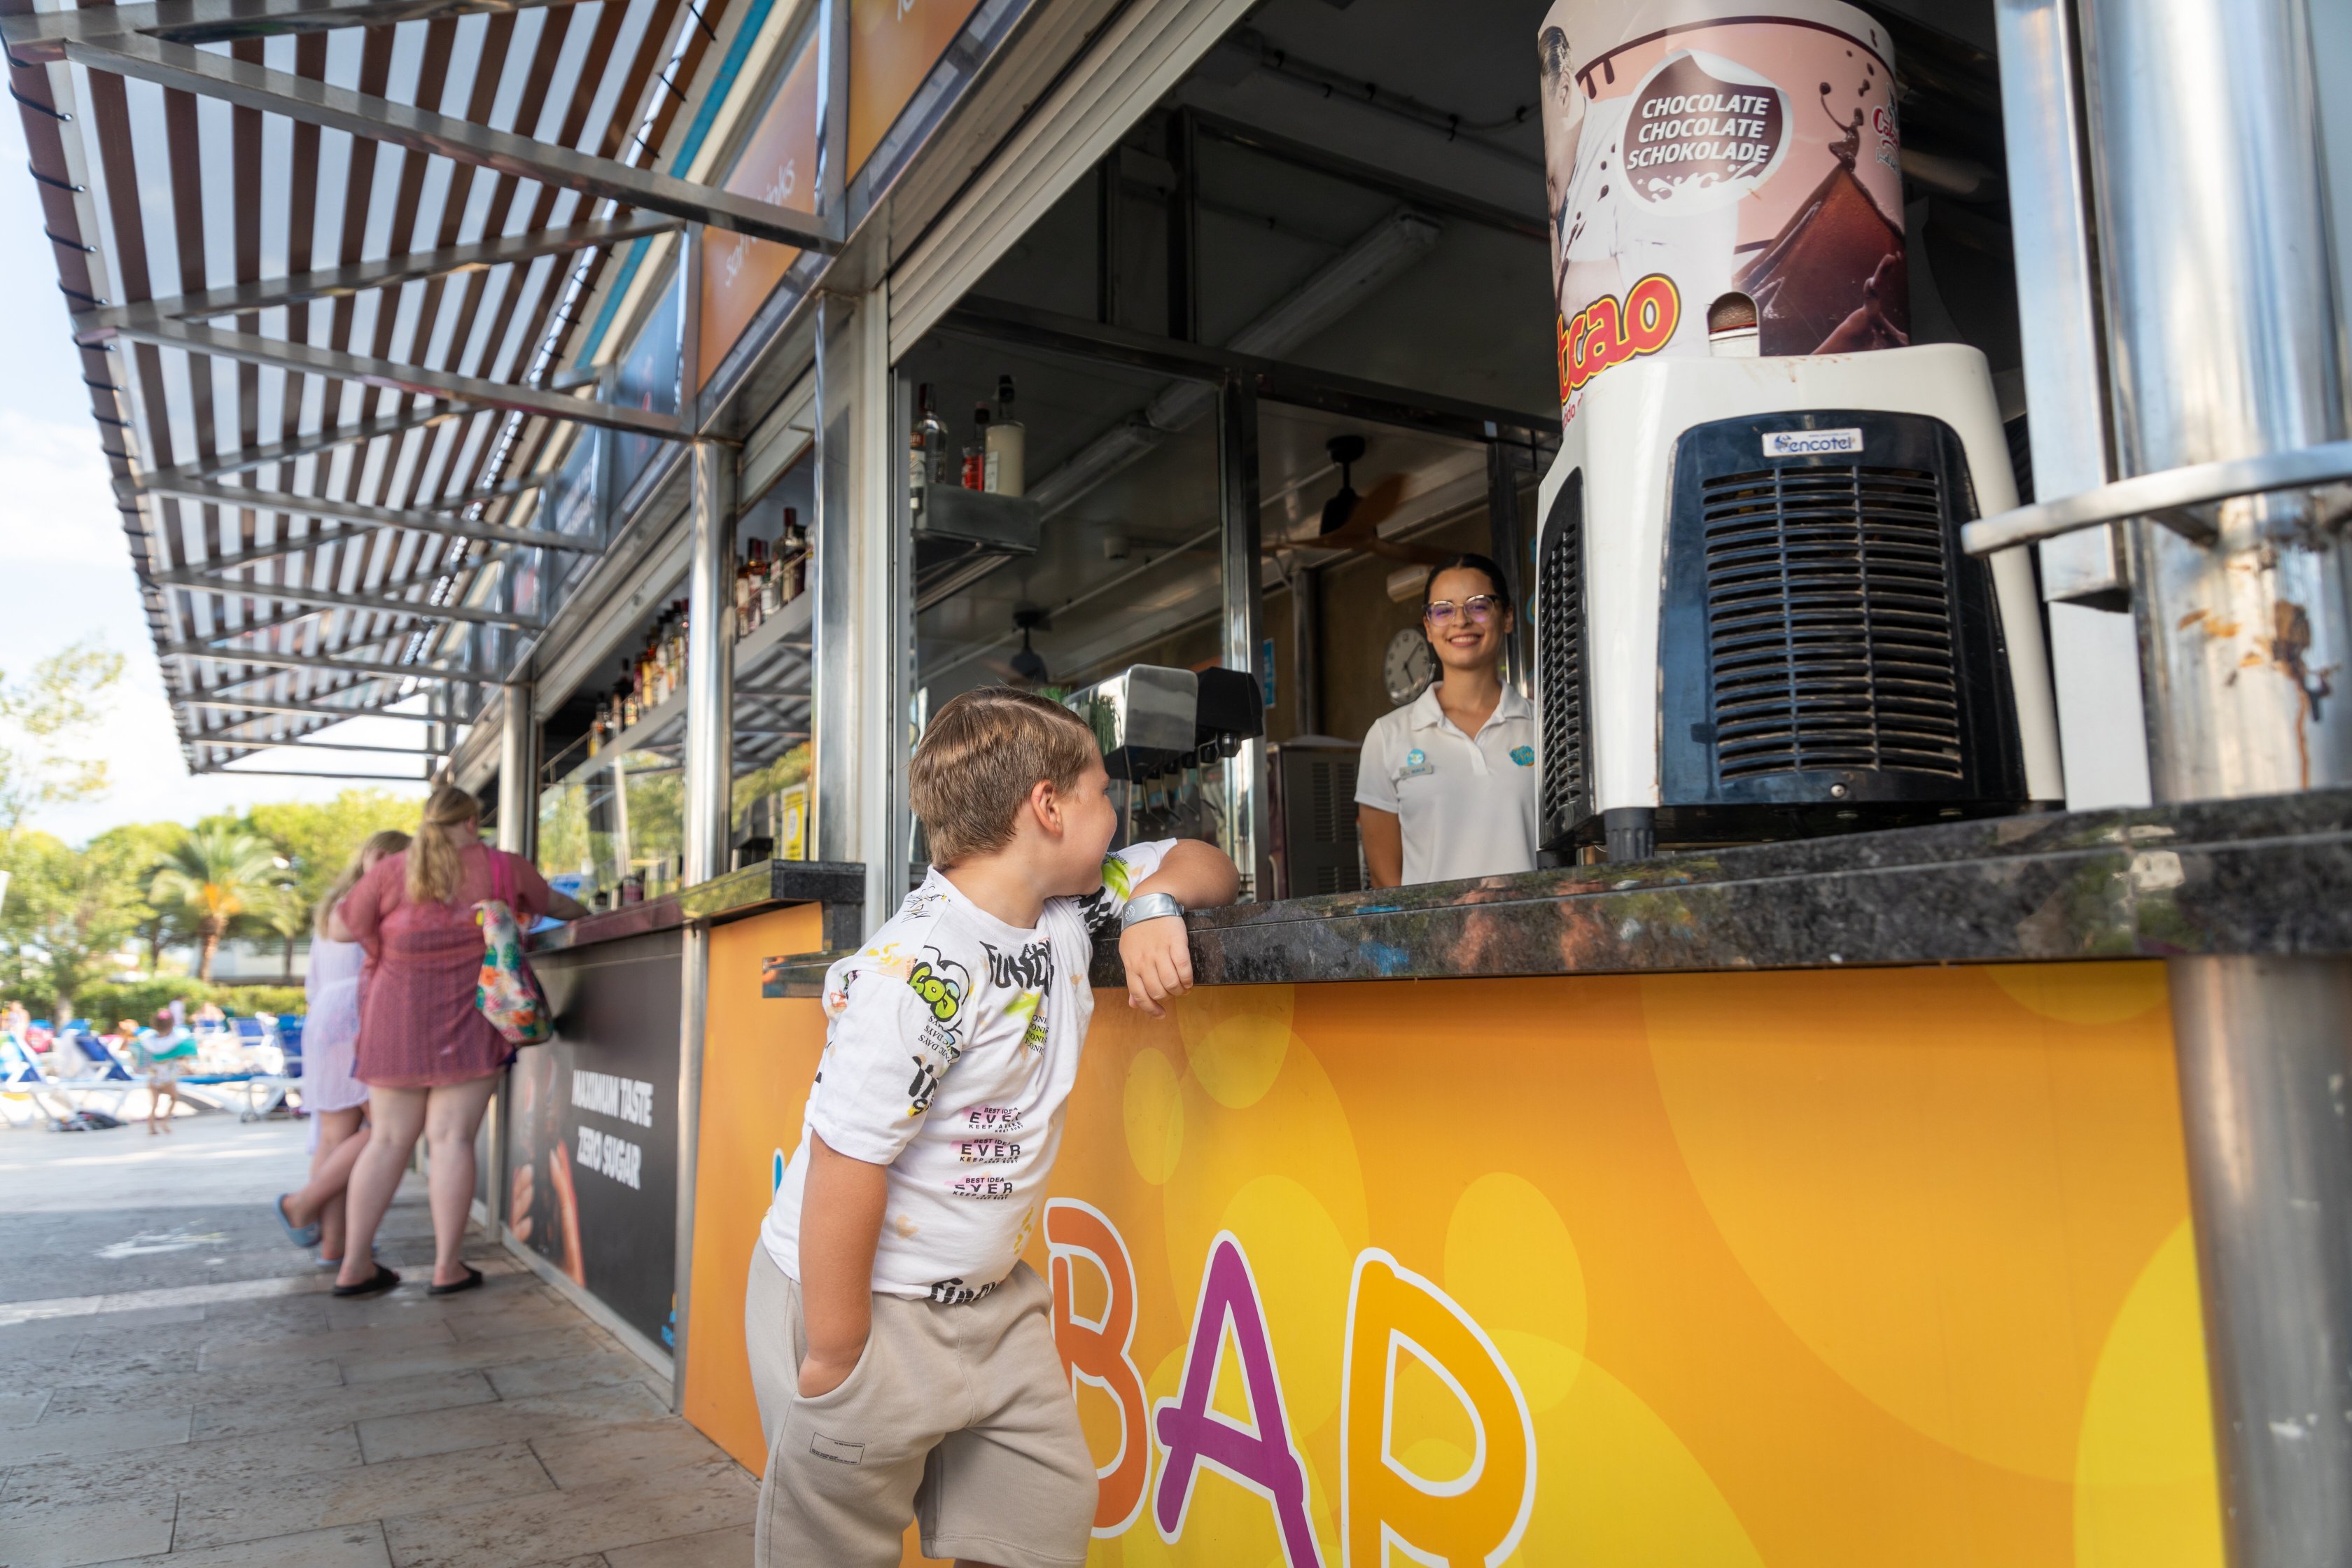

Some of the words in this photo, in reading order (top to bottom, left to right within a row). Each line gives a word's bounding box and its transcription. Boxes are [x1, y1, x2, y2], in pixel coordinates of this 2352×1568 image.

[1642, 94, 1771, 118] CHOCOLATE
[1638, 118, 1766, 143] CHOCOLATE
[1627, 141, 1770, 170] SCHOKOLADE
[918, 1034, 938, 1051] DAYS
[571, 1069, 620, 1118] MAXIMUM
[620, 1077, 654, 1128] TASTE
[577, 1125, 603, 1172] ZERO
[602, 1134, 642, 1191] SUGAR
[961, 1144, 1021, 1157] EVER
[1044, 1198, 1537, 1568] BAR
